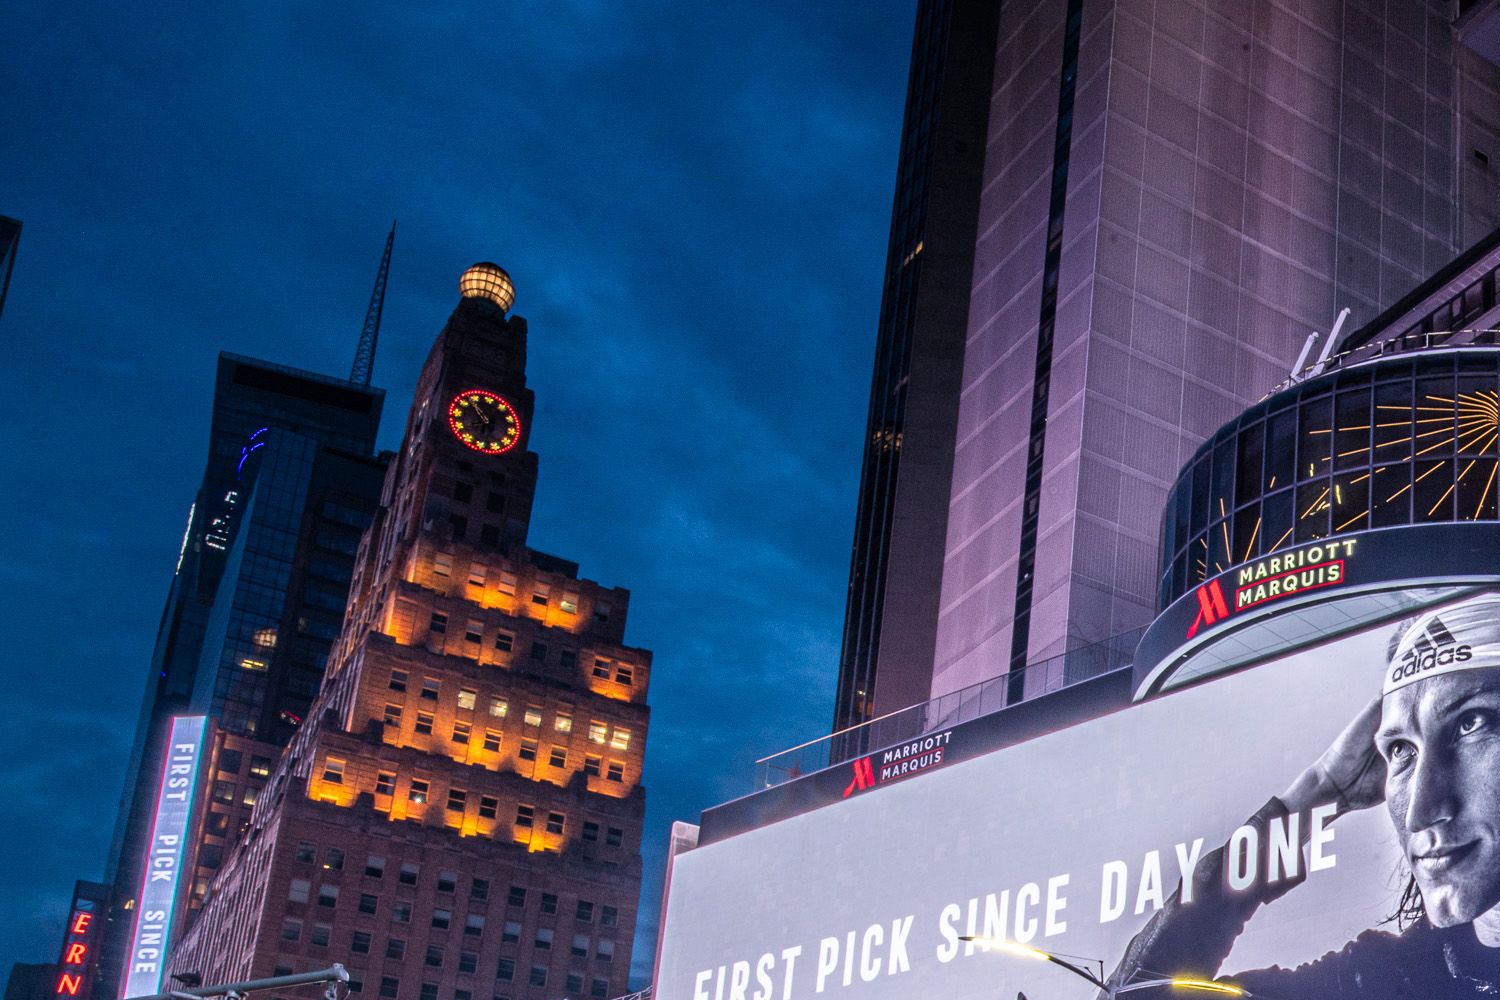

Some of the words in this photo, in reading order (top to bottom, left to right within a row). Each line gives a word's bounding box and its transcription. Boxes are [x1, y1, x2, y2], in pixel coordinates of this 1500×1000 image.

[1237, 562, 1342, 608] MARQUIS
[1238, 539, 1357, 586] MARRIOTT
[1391, 645, 1472, 684] adidas
[881, 750, 942, 780] MARQUIS
[883, 731, 951, 764] MARRIOTT
[165, 743, 195, 801] FIRST
[151, 833, 178, 882] PICK
[815, 915, 914, 993] PICK
[936, 872, 1070, 964] SINCE
[1100, 837, 1204, 923] DAY
[1227, 801, 1338, 891] ONE
[134, 909, 166, 974] SINCE
